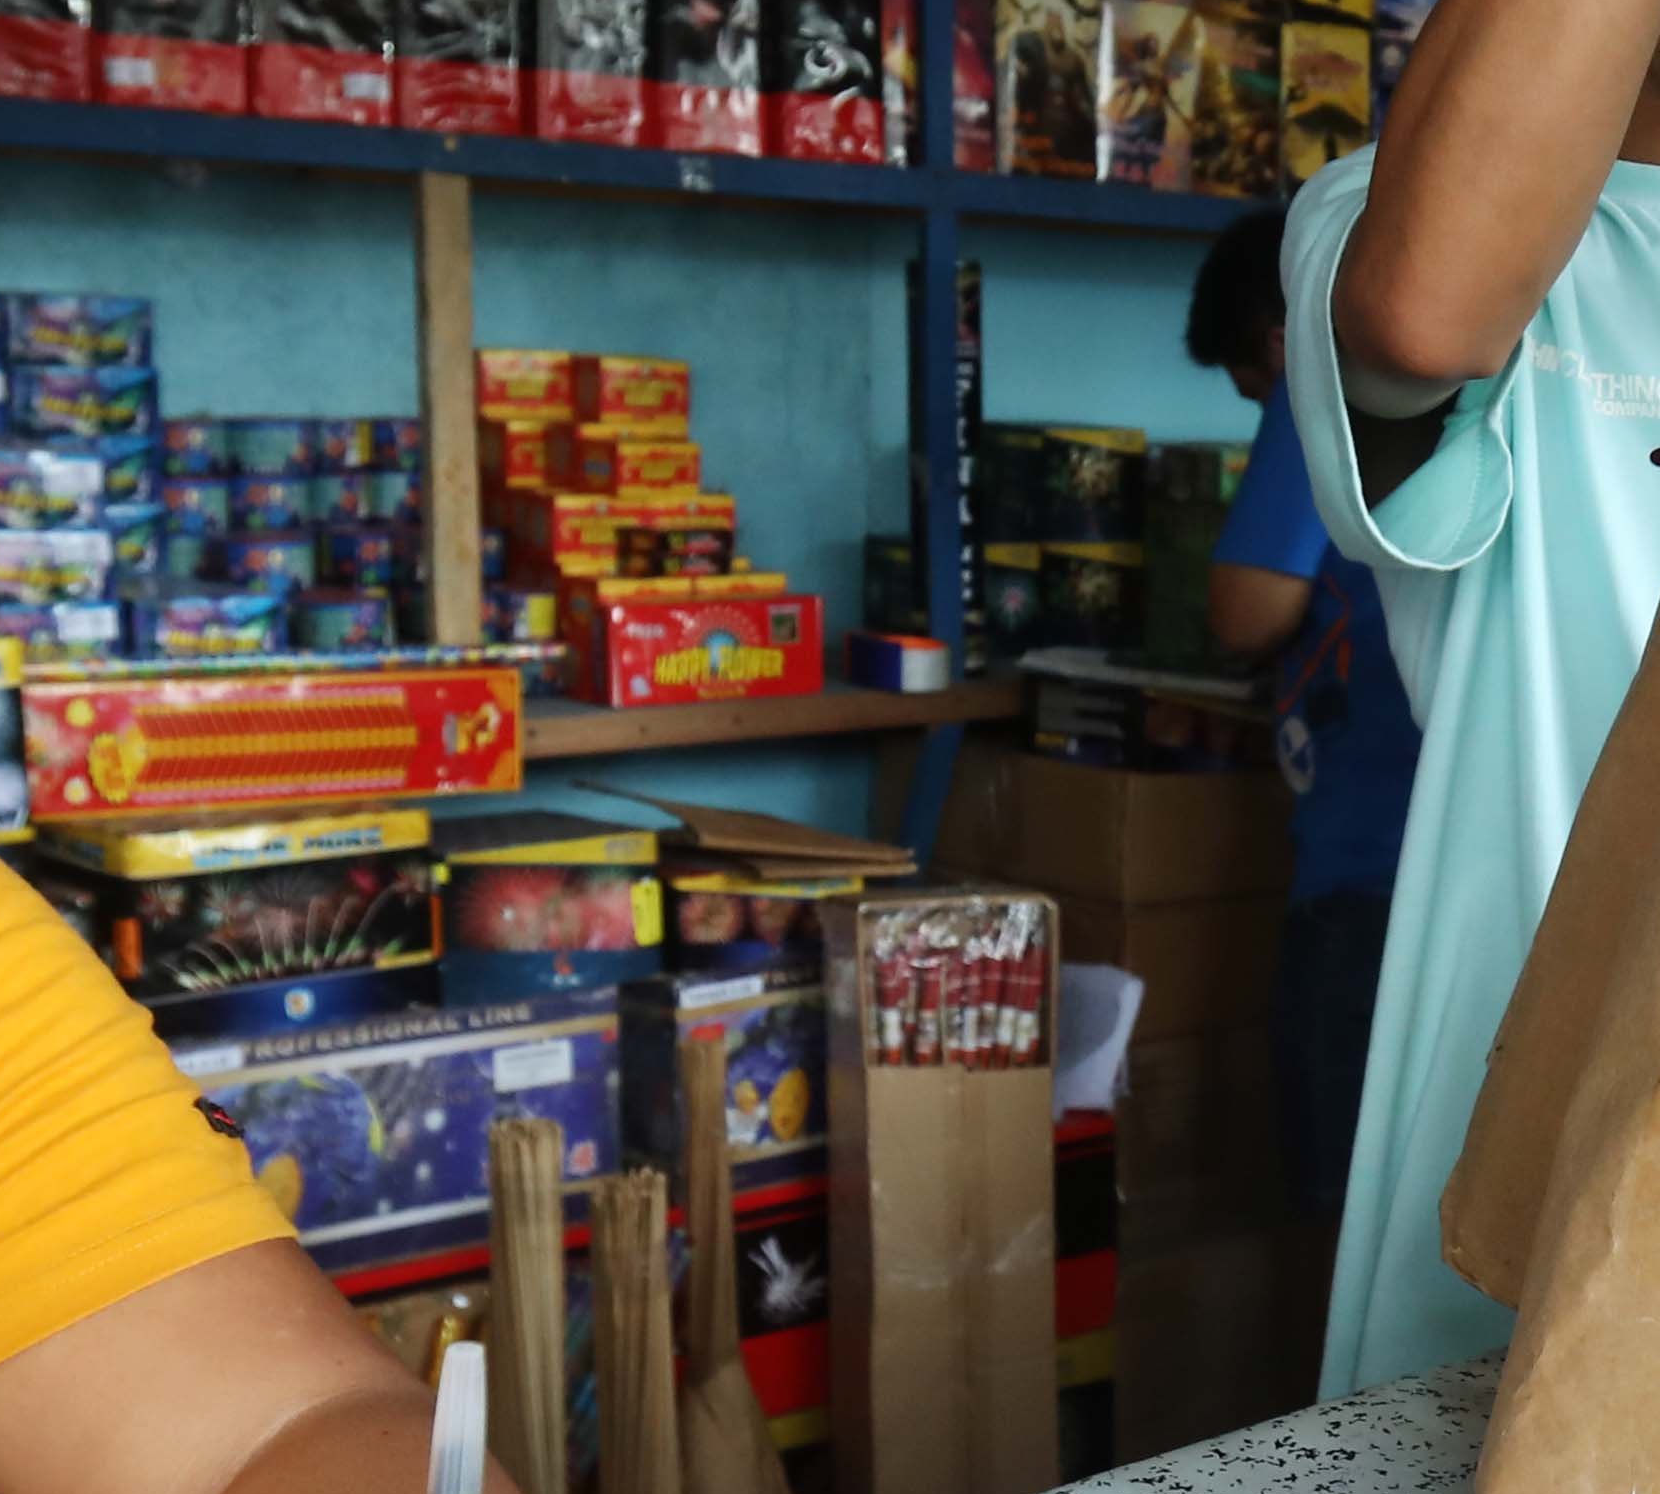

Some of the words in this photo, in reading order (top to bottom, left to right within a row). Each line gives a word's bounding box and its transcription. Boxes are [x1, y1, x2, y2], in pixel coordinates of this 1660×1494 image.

[653, 647, 713, 686] HAPPY
[717, 645, 785, 682] FLOWER
[468, 1000, 531, 1028] LINE
